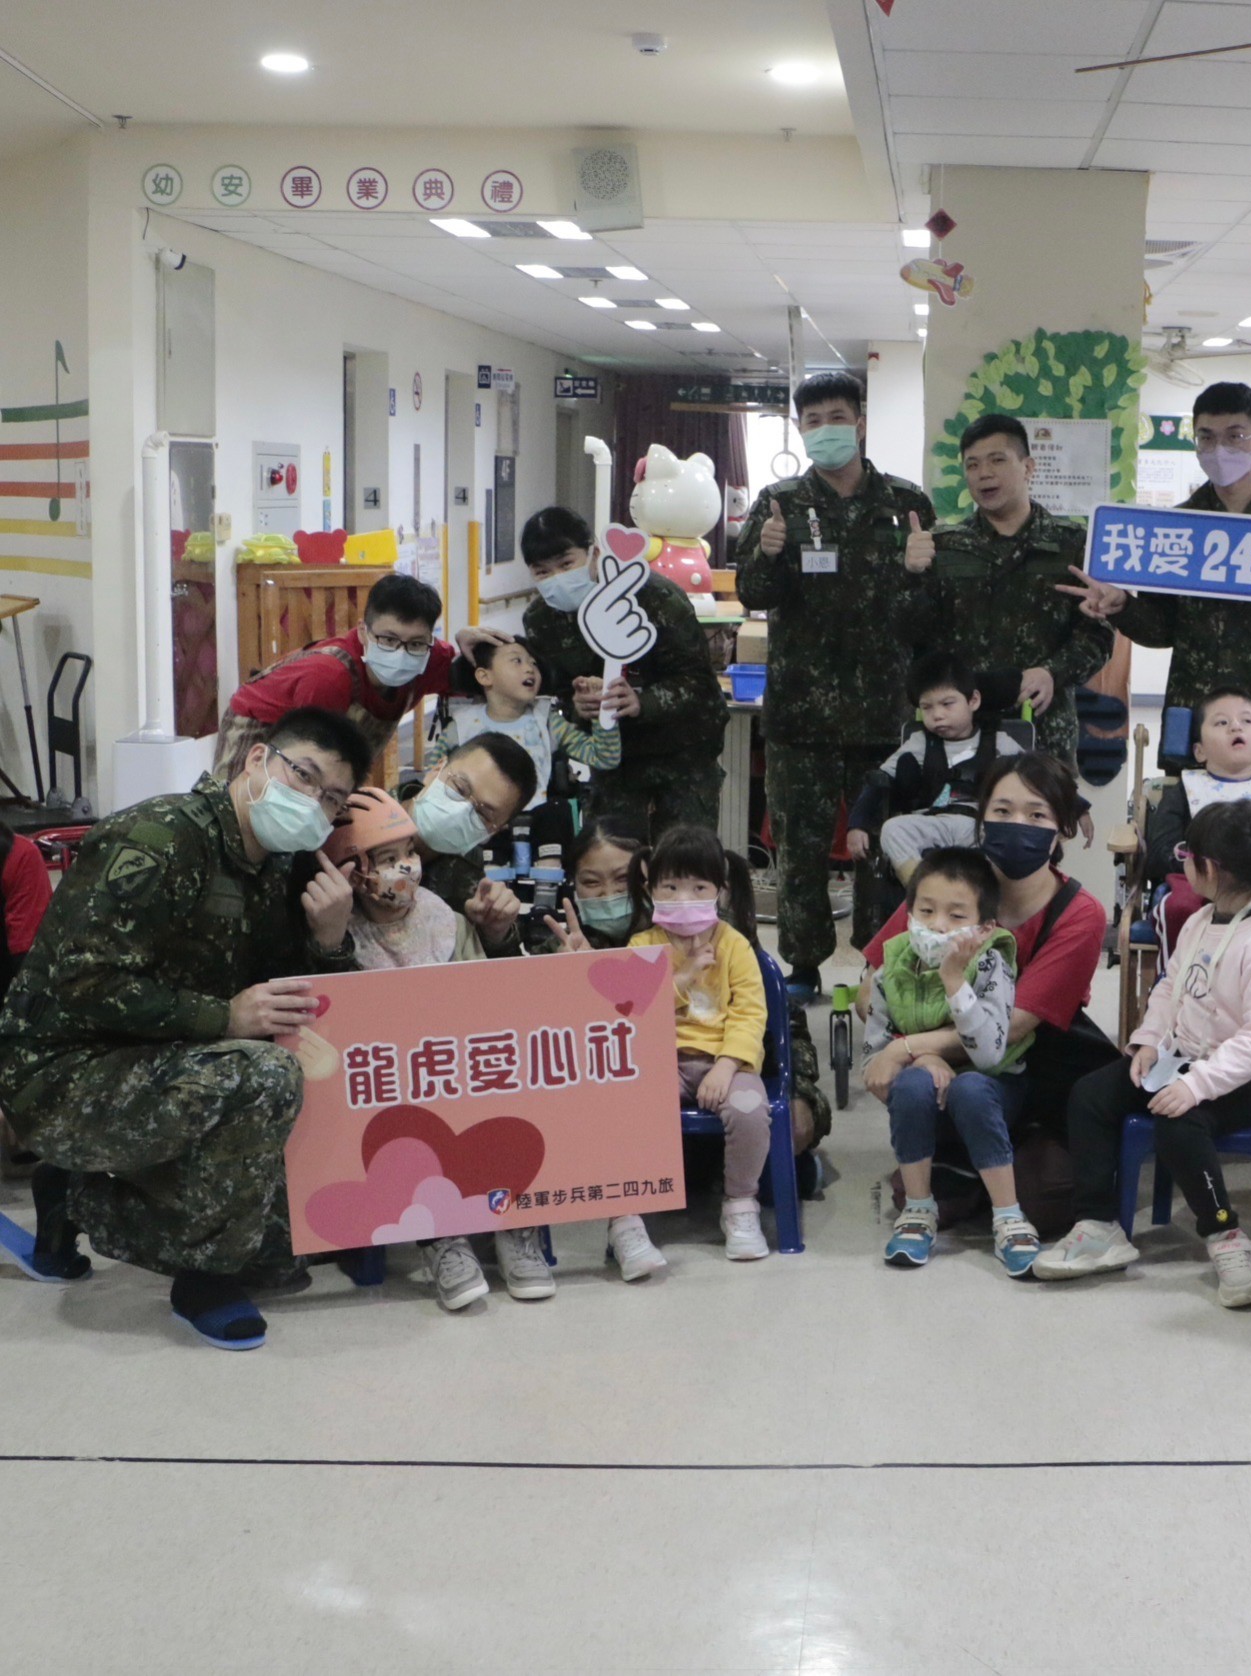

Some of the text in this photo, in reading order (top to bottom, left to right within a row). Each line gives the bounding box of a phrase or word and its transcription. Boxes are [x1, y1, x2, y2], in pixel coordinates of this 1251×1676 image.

[151, 172, 514, 204] 幼安畢業典禮
[363, 488, 380, 507] 4
[455, 487, 468, 503] 4
[344, 1019, 639, 1108] 龍虎愛心社
[516, 1177, 674, 1210] 陸軍步兵第二四九旅
